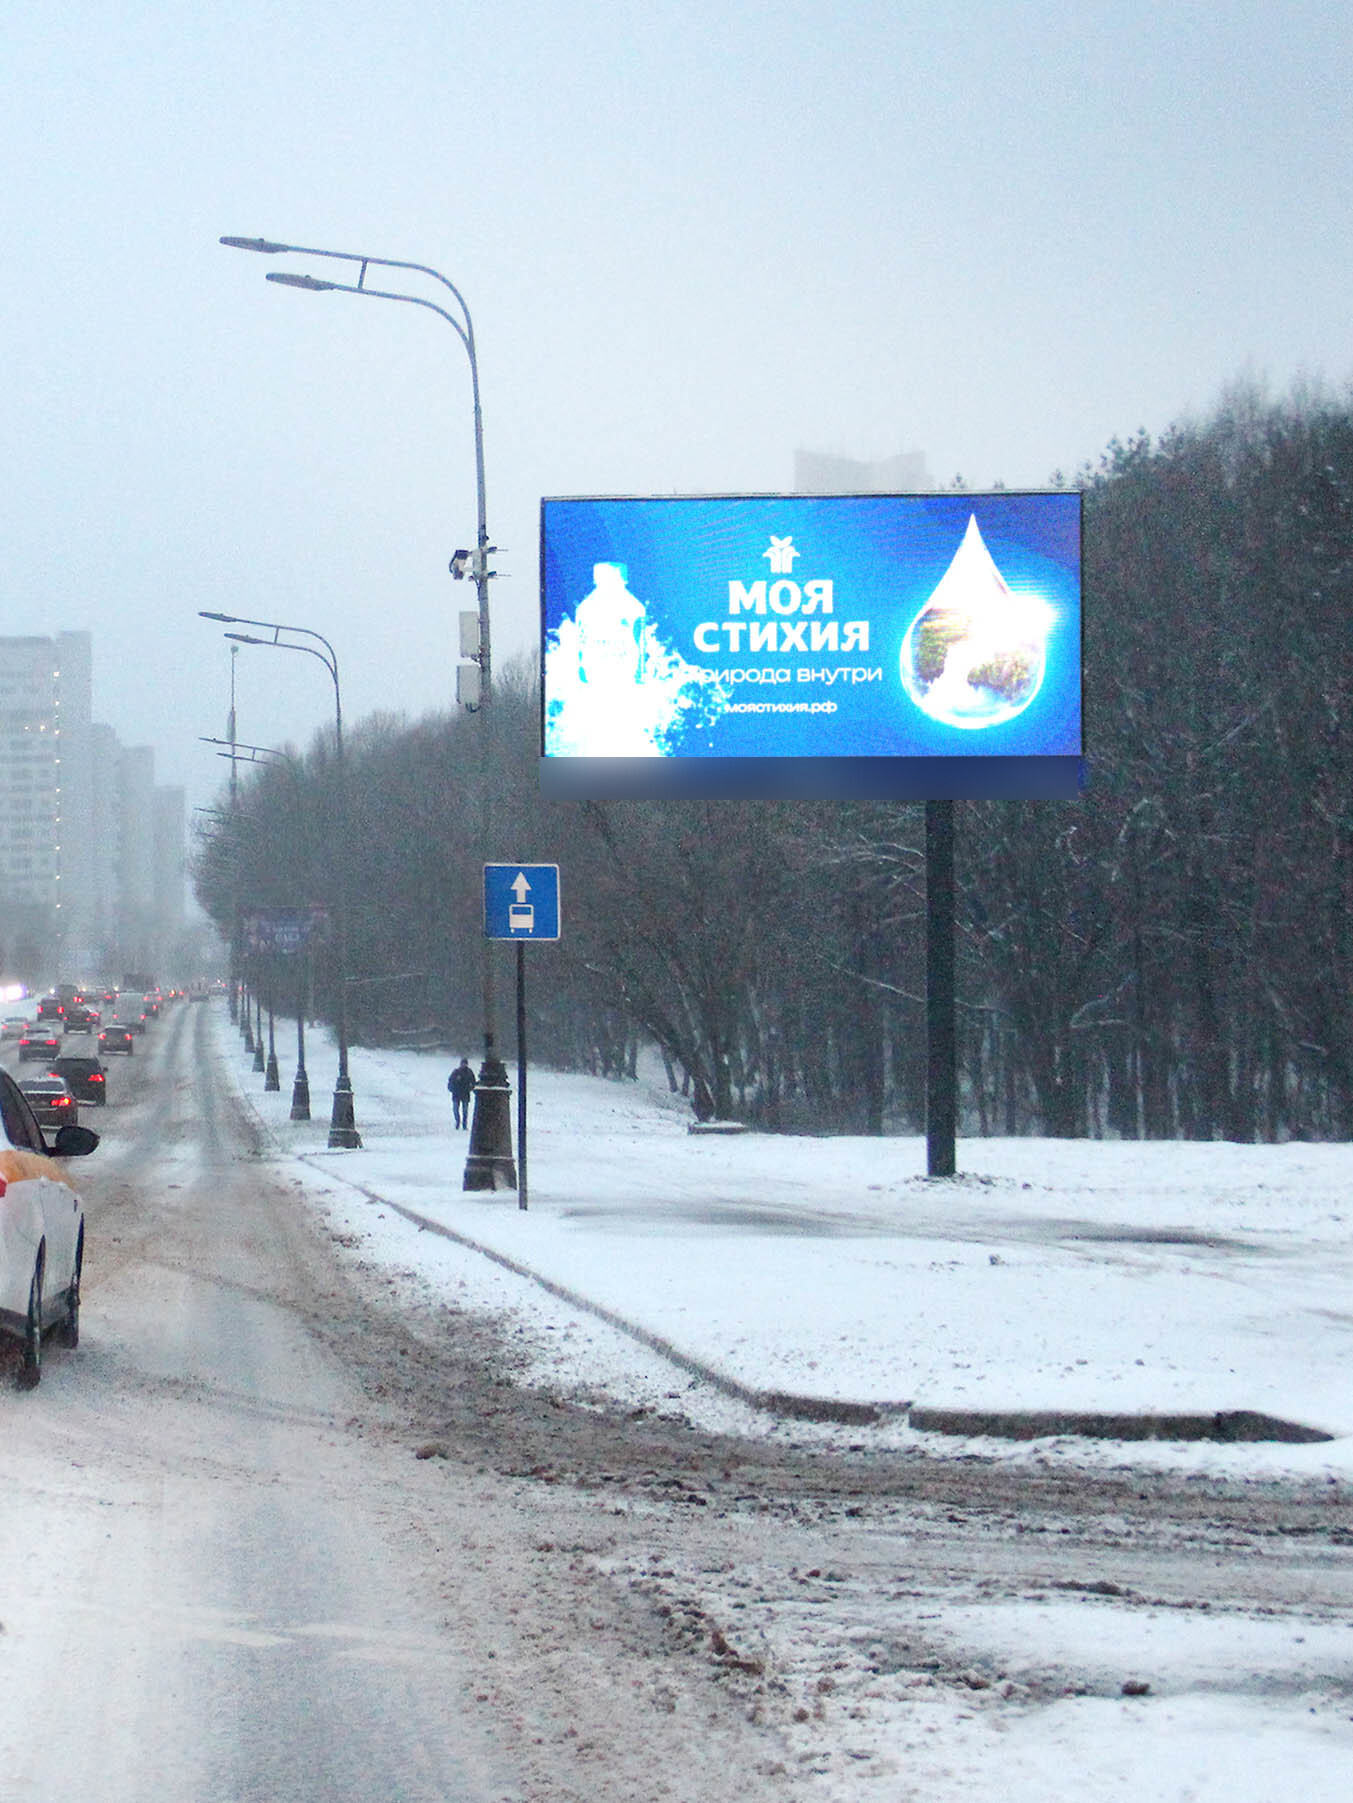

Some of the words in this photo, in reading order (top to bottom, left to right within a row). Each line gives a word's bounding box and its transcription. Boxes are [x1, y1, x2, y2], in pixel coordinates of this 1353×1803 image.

[728, 579, 834, 615] МОЯ
[693, 620, 870, 653] СТИХИЯ
[692, 666, 791, 686] рирода
[796, 666, 883, 685] внутри
